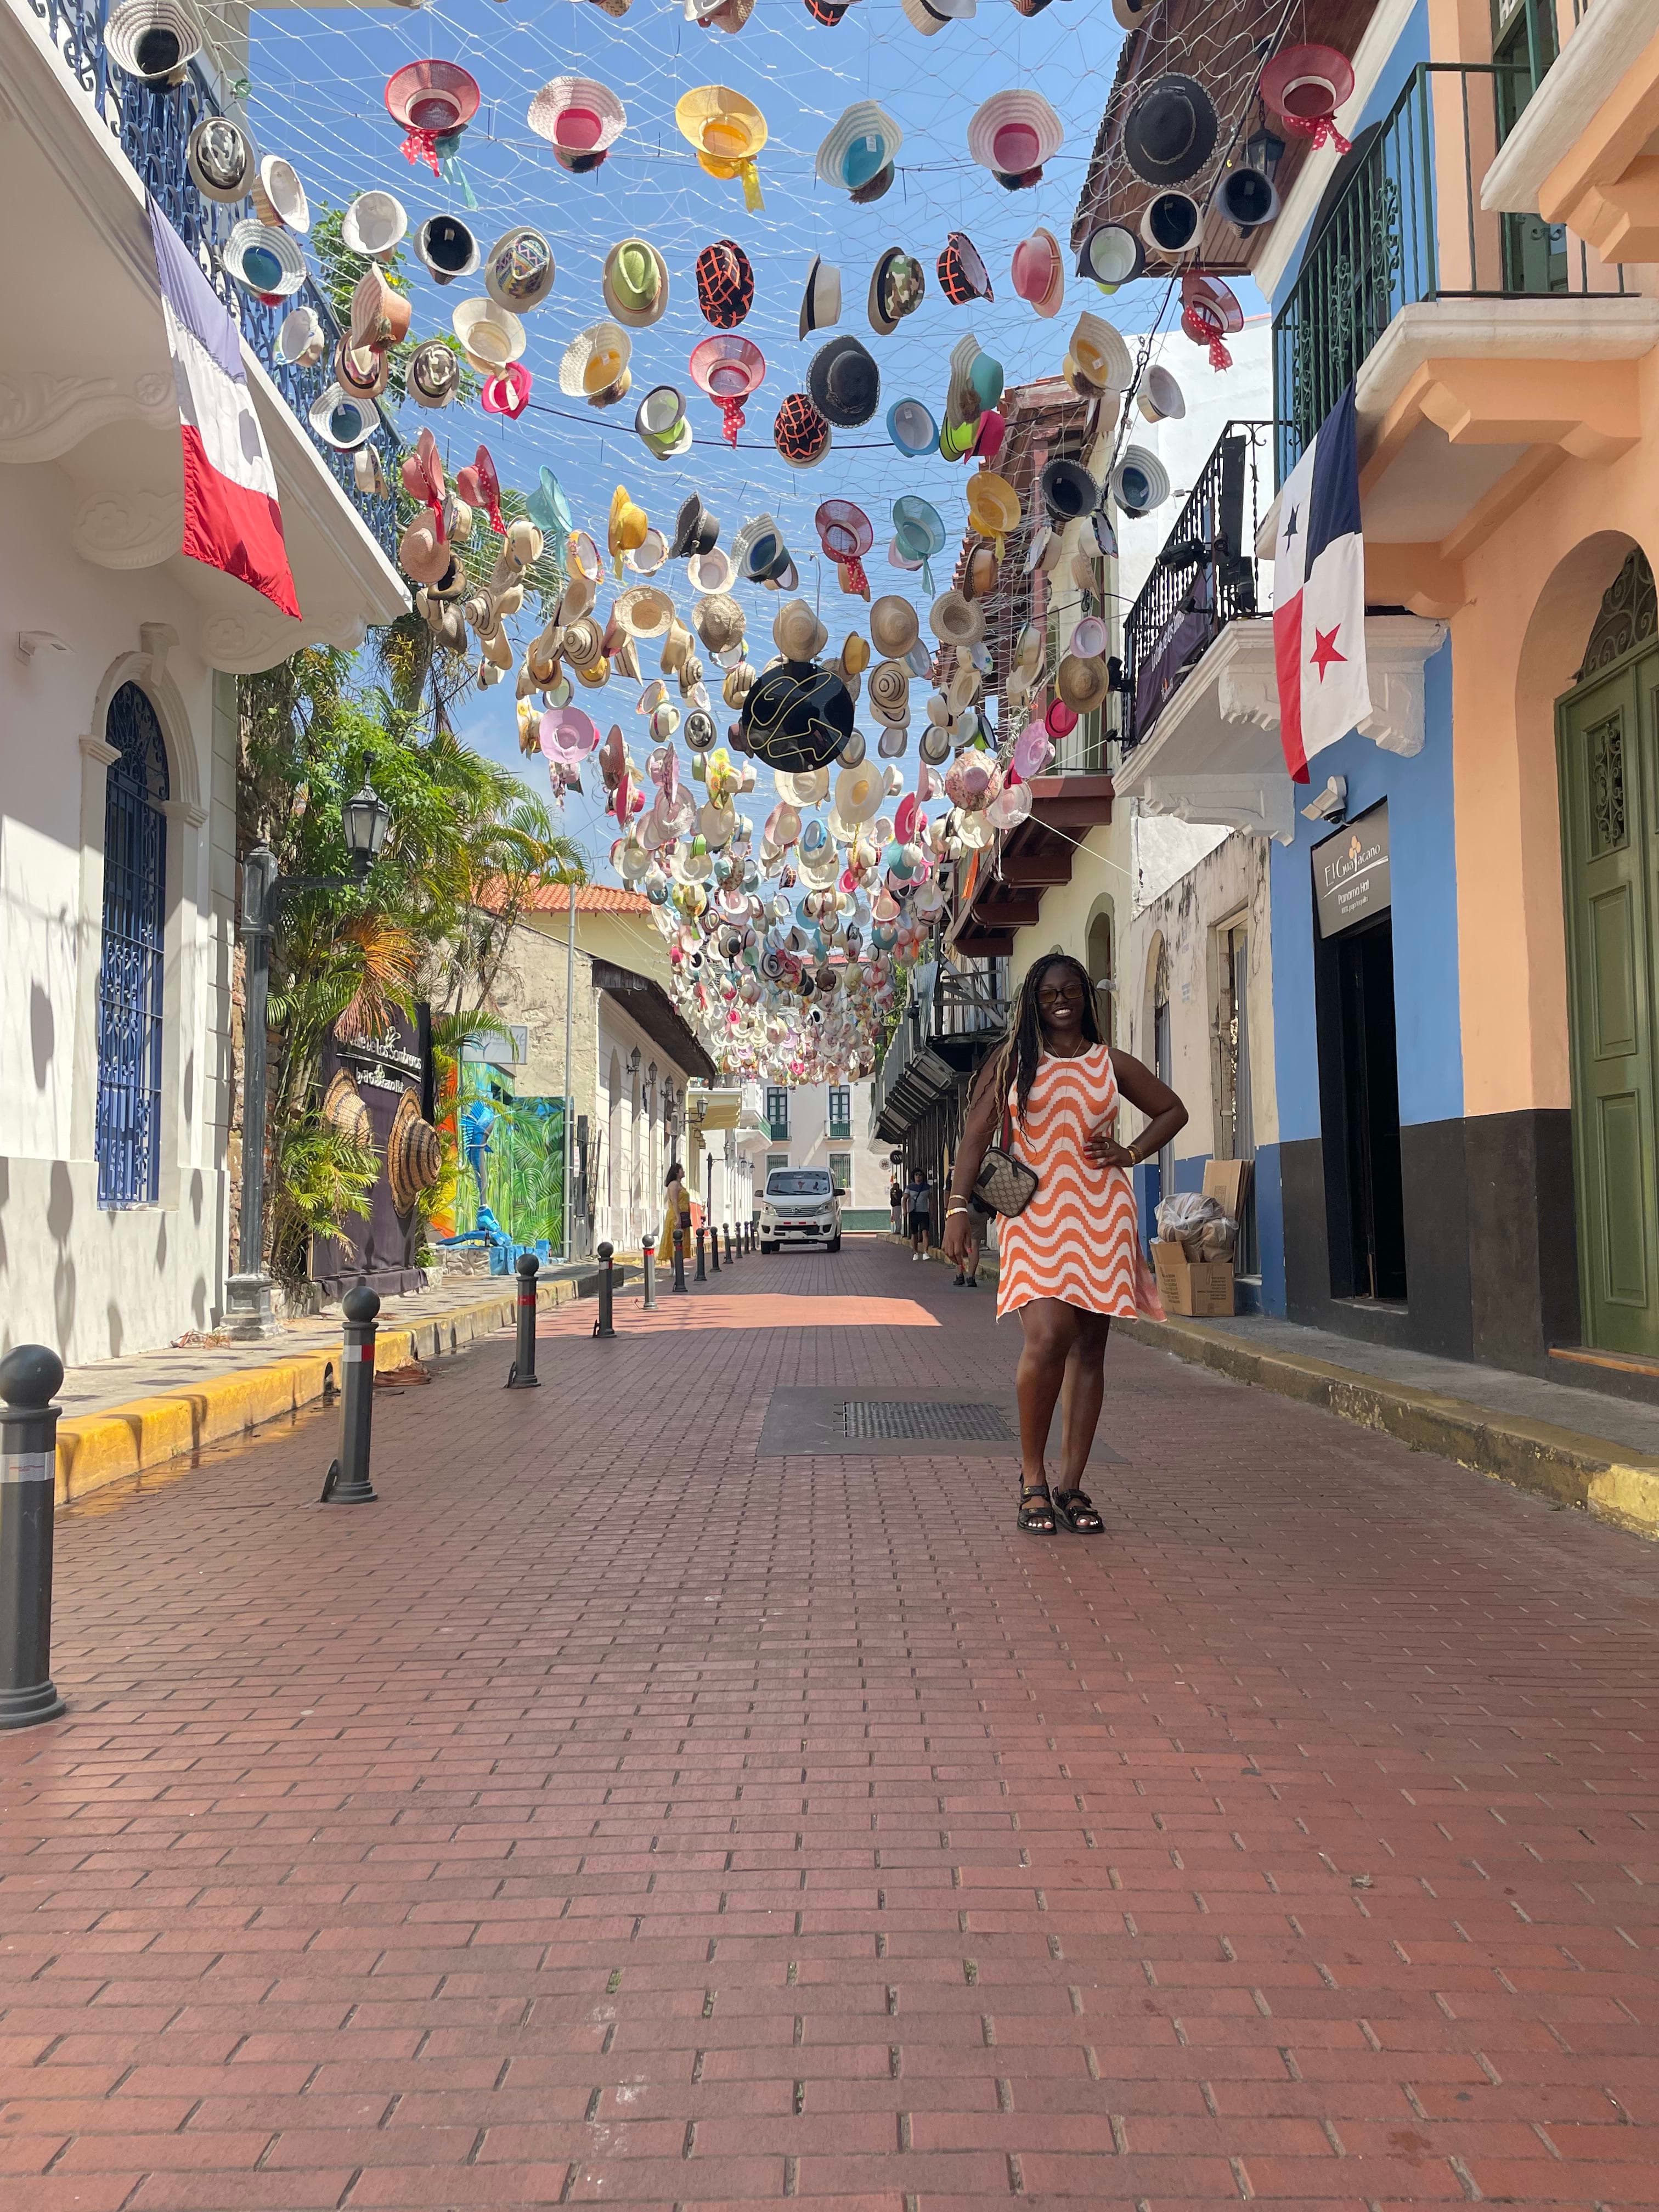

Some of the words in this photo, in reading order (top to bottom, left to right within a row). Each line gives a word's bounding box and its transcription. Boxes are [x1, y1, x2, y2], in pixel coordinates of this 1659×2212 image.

[1324, 863, 1335, 887] El
[1336, 844, 1380, 877] Guayacano
[1338, 886, 1360, 905] Panama
[1360, 879, 1370, 894] Hat
[376, 1037, 388, 1058] Los
[357, 1067, 363, 1085] by
